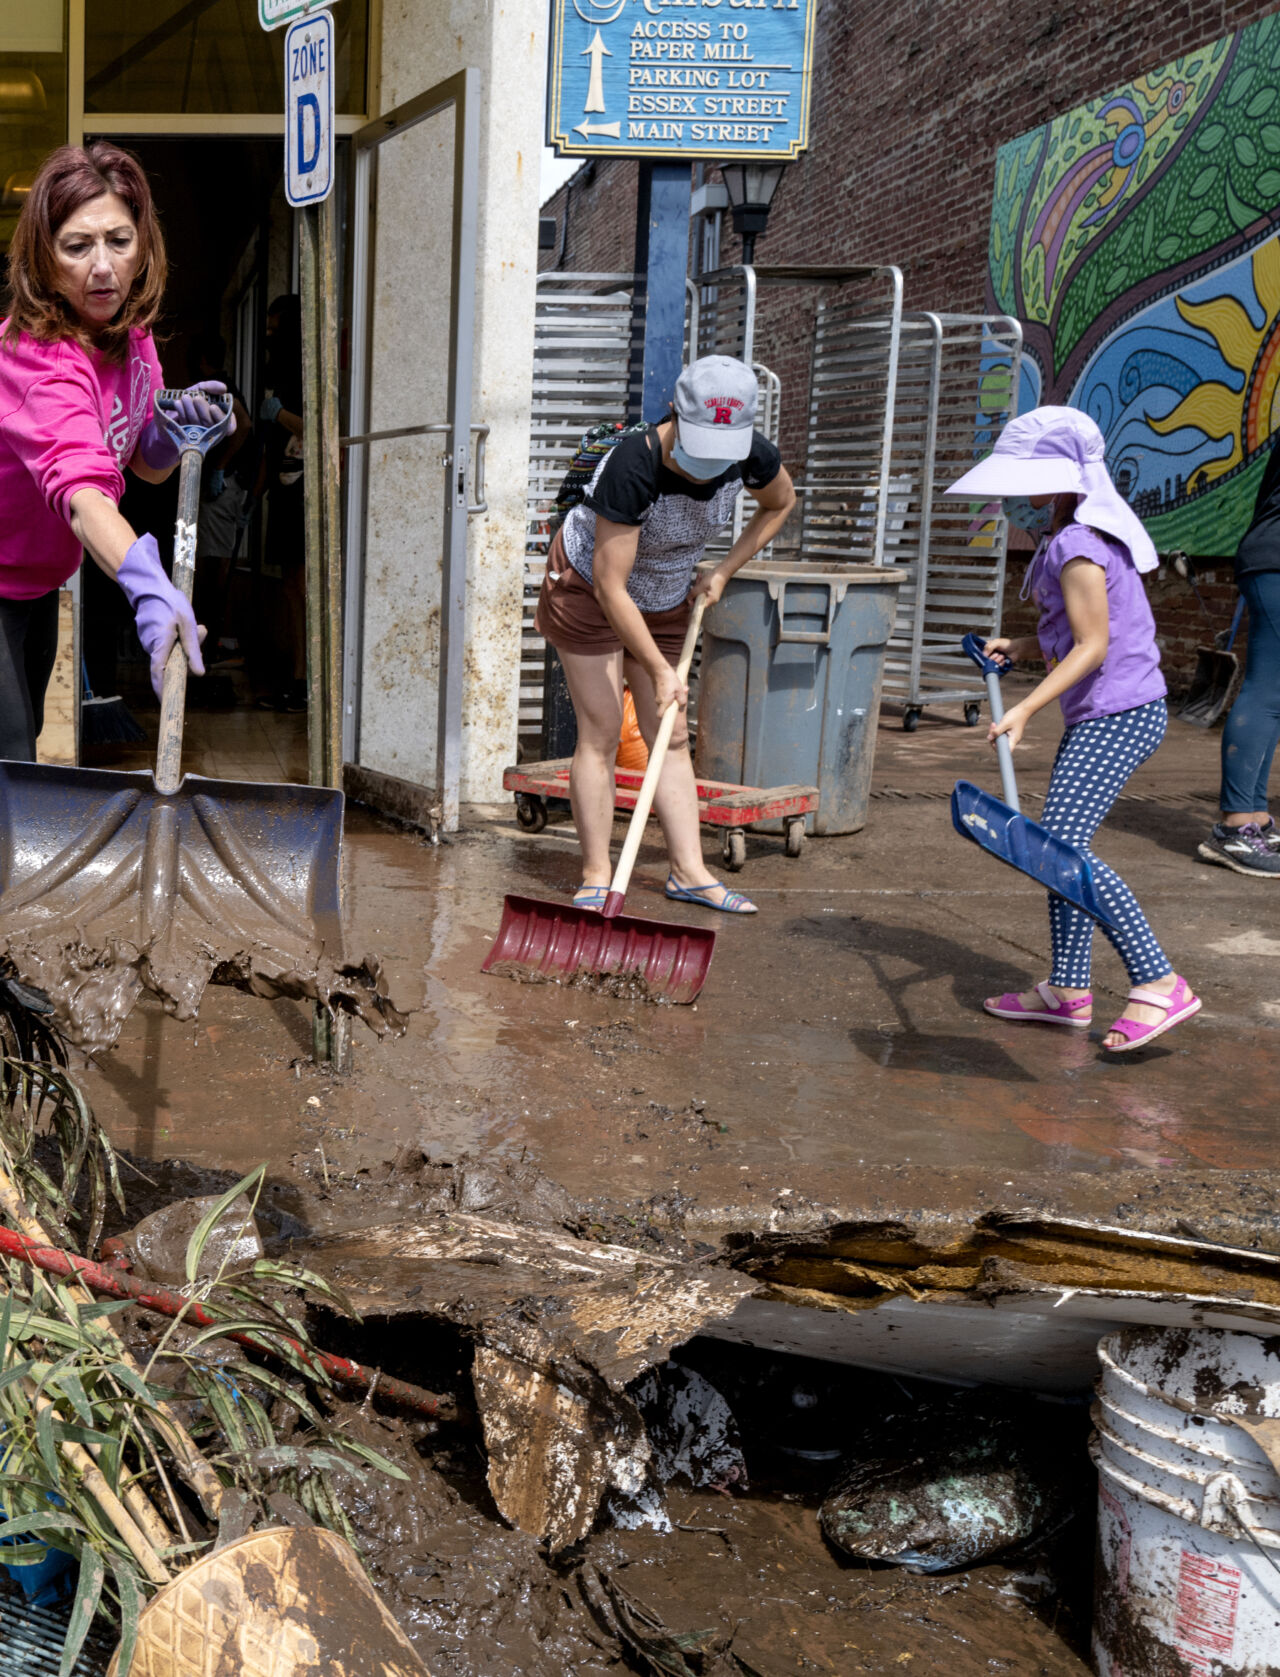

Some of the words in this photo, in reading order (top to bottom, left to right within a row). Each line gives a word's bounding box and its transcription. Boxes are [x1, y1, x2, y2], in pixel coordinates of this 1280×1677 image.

[630, 21, 711, 40] ACCESS
[719, 23, 748, 41] TO
[292, 39, 326, 82] ZONE
[629, 41, 696, 60] PAPER
[702, 43, 754, 61] MILL
[628, 68, 720, 88] PARKING
[727, 70, 770, 89] LOT
[627, 95, 696, 114] ESSEX
[704, 97, 788, 116] STREET
[297, 92, 321, 175] D
[627, 122, 684, 141] MAIN
[691, 124, 774, 143] STREET
[713, 407, 732, 424] R
